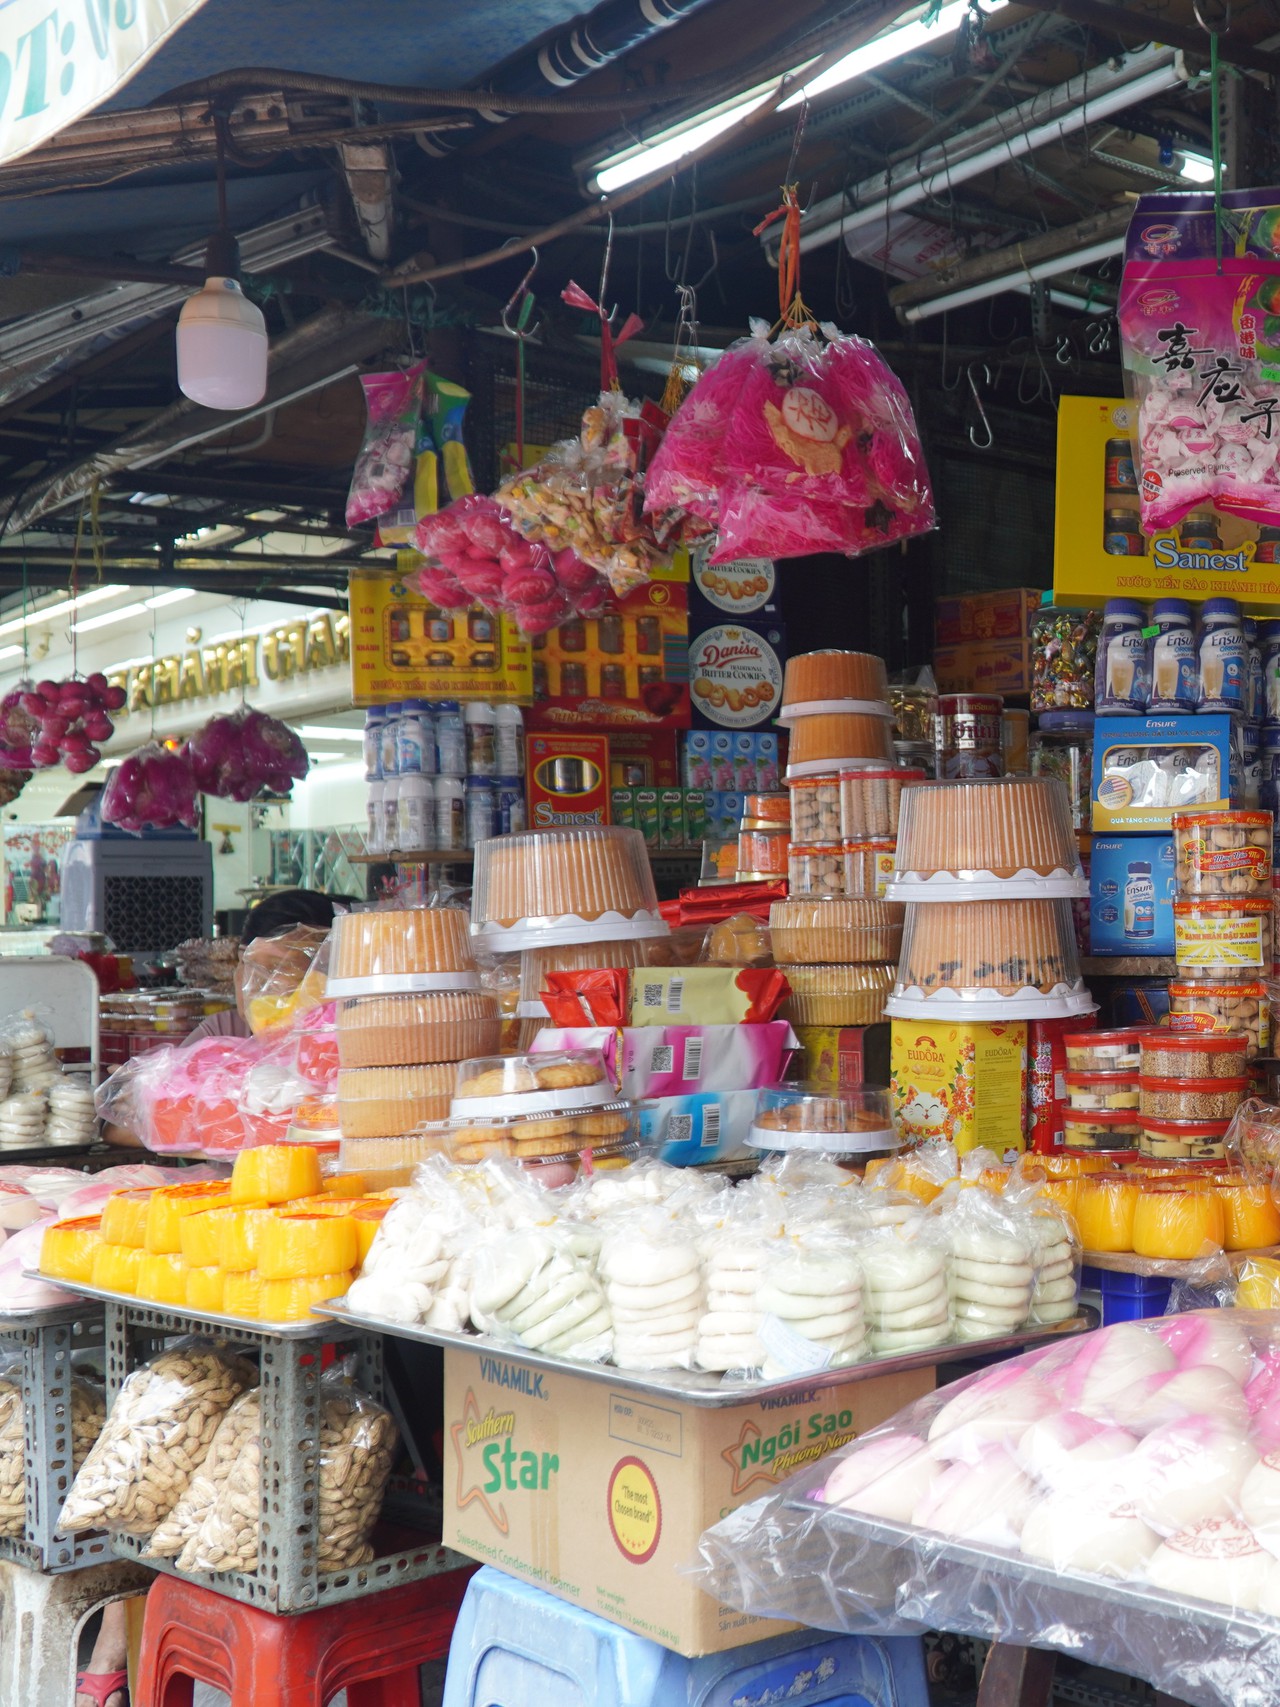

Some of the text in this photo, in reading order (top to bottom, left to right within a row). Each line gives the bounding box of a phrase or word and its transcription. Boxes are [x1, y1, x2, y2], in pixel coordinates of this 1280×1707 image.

[1168, 464, 1206, 478] Preserved
[1153, 537, 1249, 572] Sanest
[1116, 575, 1150, 588] NƯỚC
[1153, 575, 1182, 590] YẾN
[1183, 576, 1208, 591] SÀO
[1211, 577, 1258, 593] KHÁNH
[700, 641, 760, 666] Danisa
[702, 668, 766, 681] BUTTER COOKIES
[1145, 719, 1177, 729] Ensure
[536, 803, 602, 825] Sanest
[1095, 842, 1123, 850] Ensure
[1126, 884, 1153, 895] Ensure
[479, 1356, 544, 1399] VINAMILK
[760, 1389, 818, 1411] VINAMILK
[464, 1409, 515, 1448] Southern
[740, 1409, 853, 1470] Ngôi Sao
[482, 1437, 559, 1494] Star
[614, 1499, 633, 1518] Chosen
[634, 1491, 649, 1505] most
[456, 1529, 581, 1598] Sweetened Condensed Creamer
